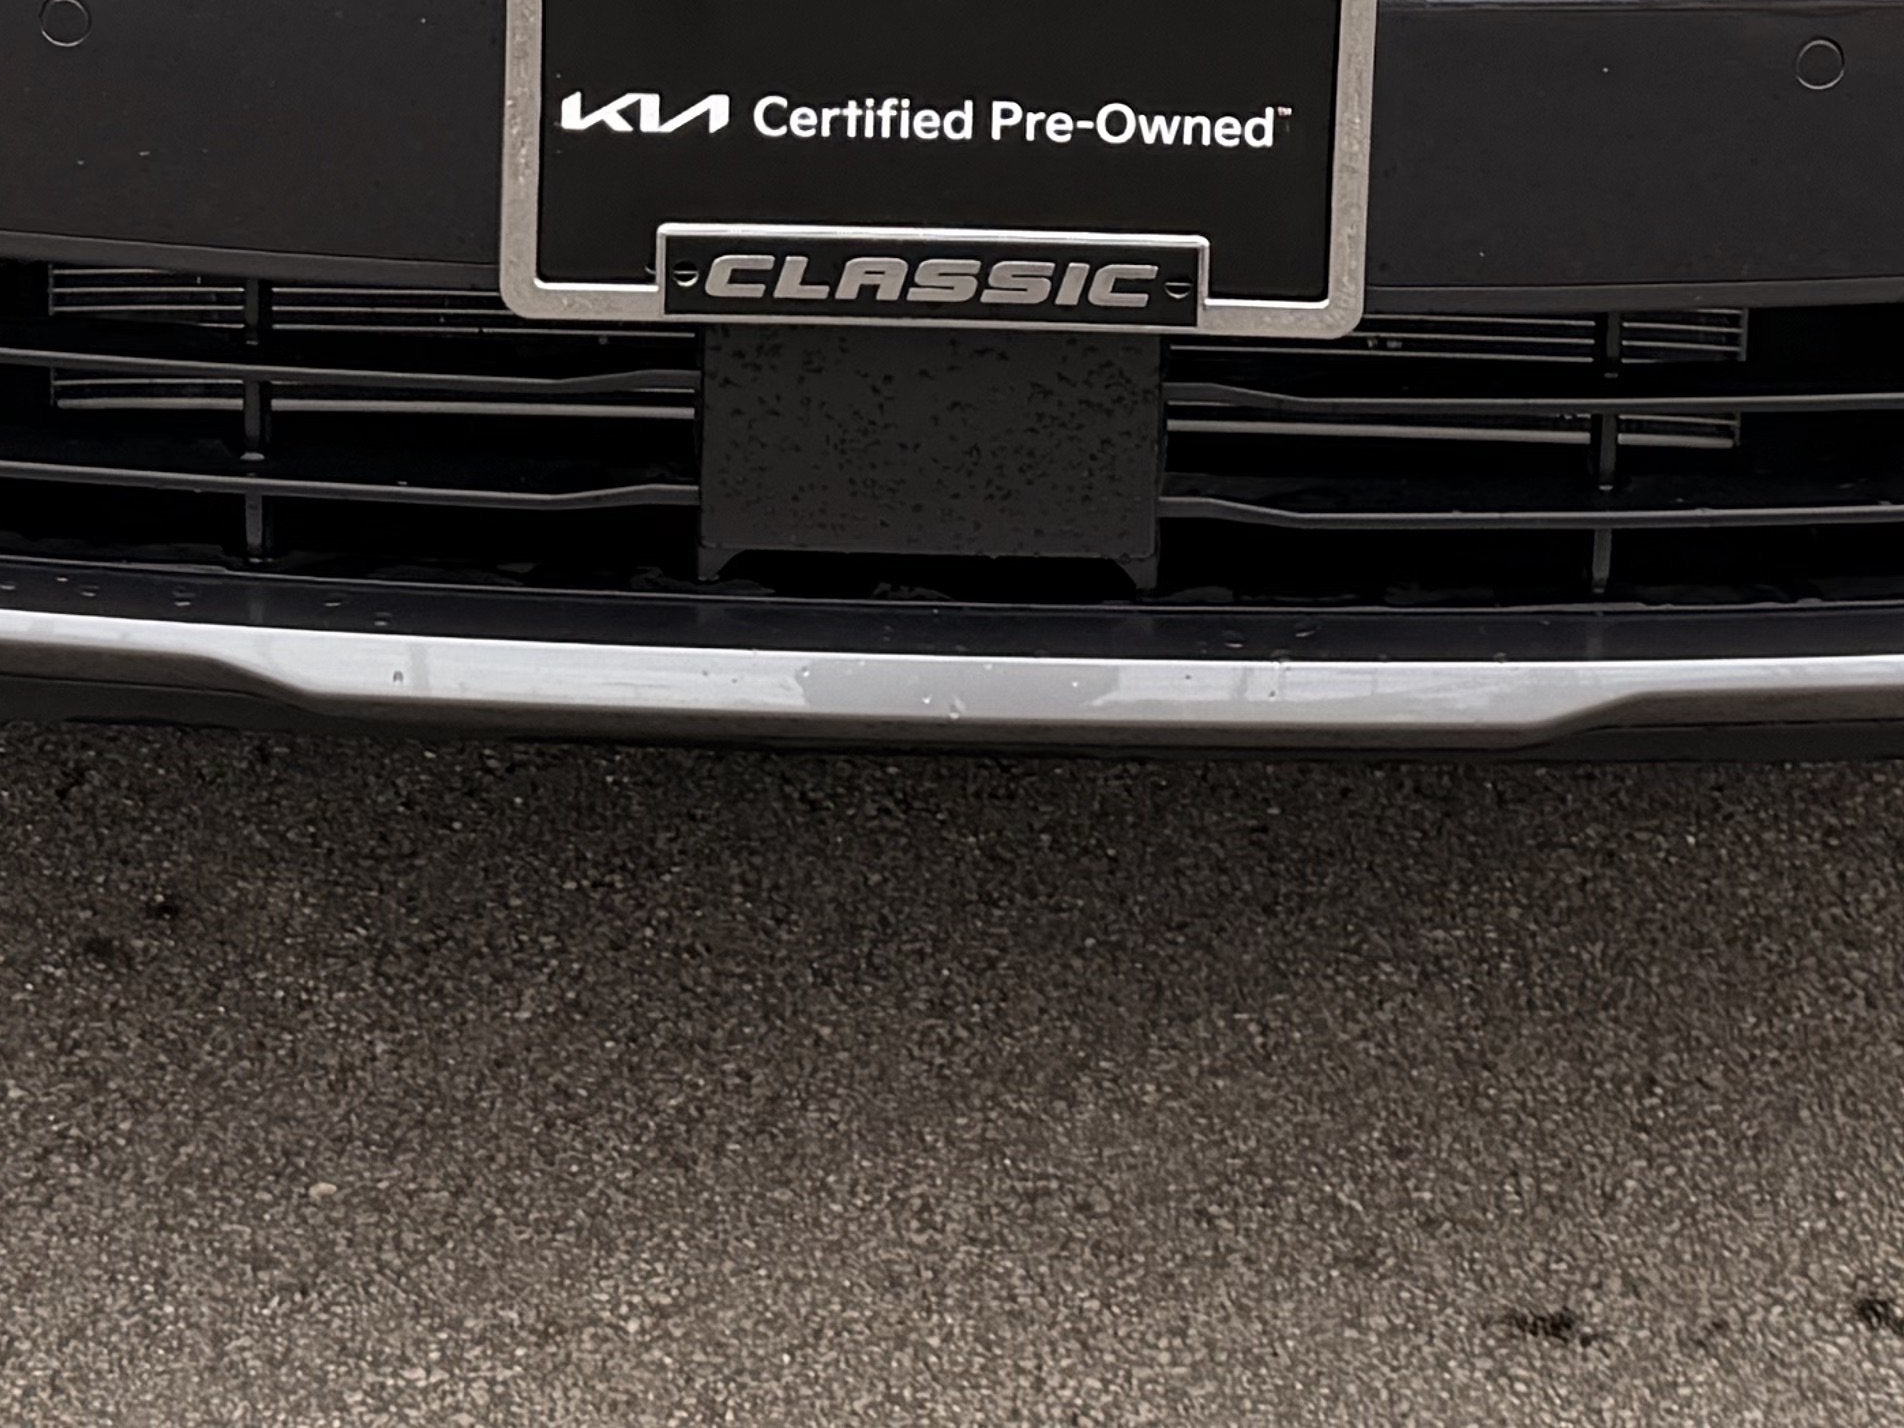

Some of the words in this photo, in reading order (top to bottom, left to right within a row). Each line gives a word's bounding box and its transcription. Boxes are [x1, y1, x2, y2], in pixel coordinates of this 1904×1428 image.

[559, 90, 730, 135] KIA
[752, 94, 975, 142] Certified
[703, 253, 1160, 308] CLASSIC
